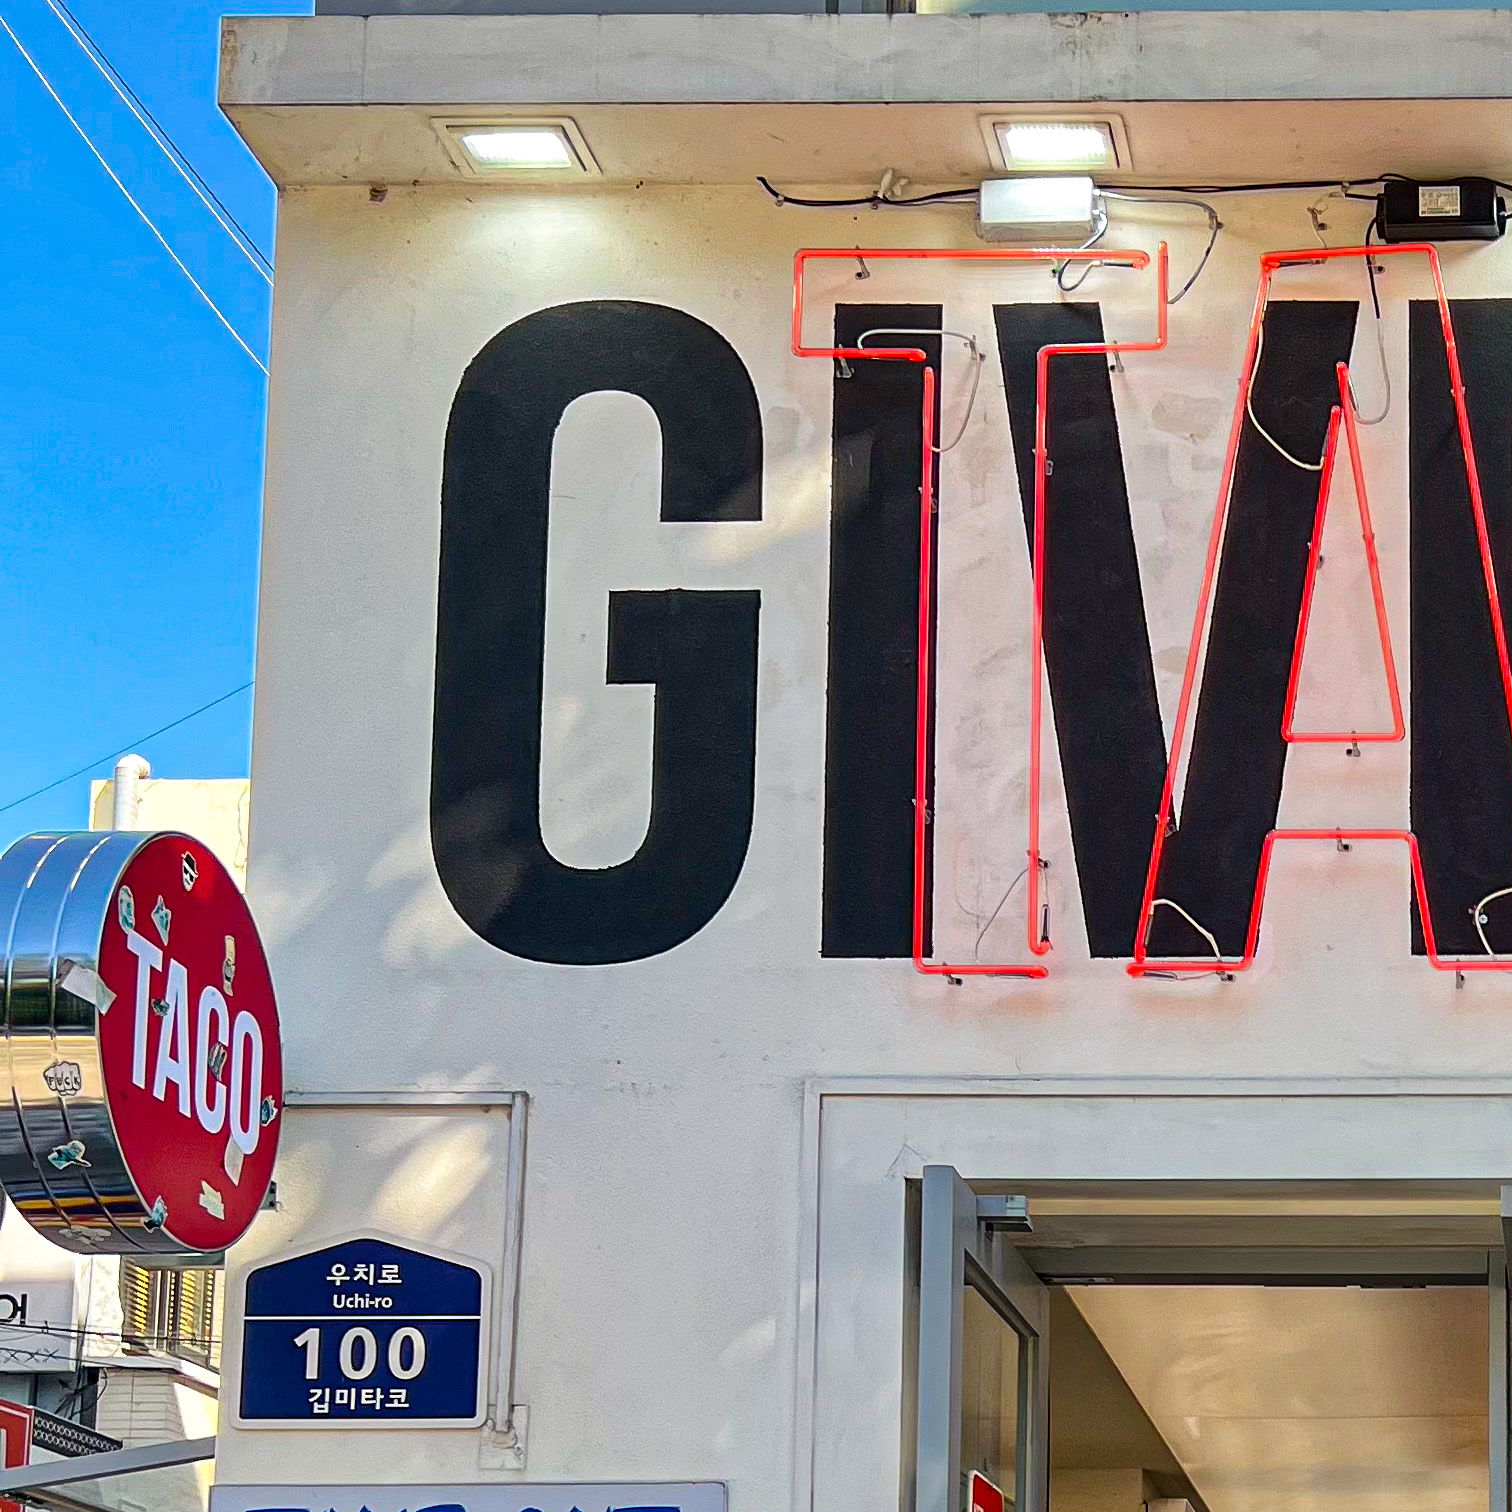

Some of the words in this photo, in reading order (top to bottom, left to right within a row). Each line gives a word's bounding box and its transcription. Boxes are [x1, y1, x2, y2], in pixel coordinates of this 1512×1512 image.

[126, 928, 264, 1156] TACO
[326, 1263, 402, 1286] 우치로
[332, 1293, 393, 1309] Uchi-ro
[293, 1326, 427, 1380] 100
